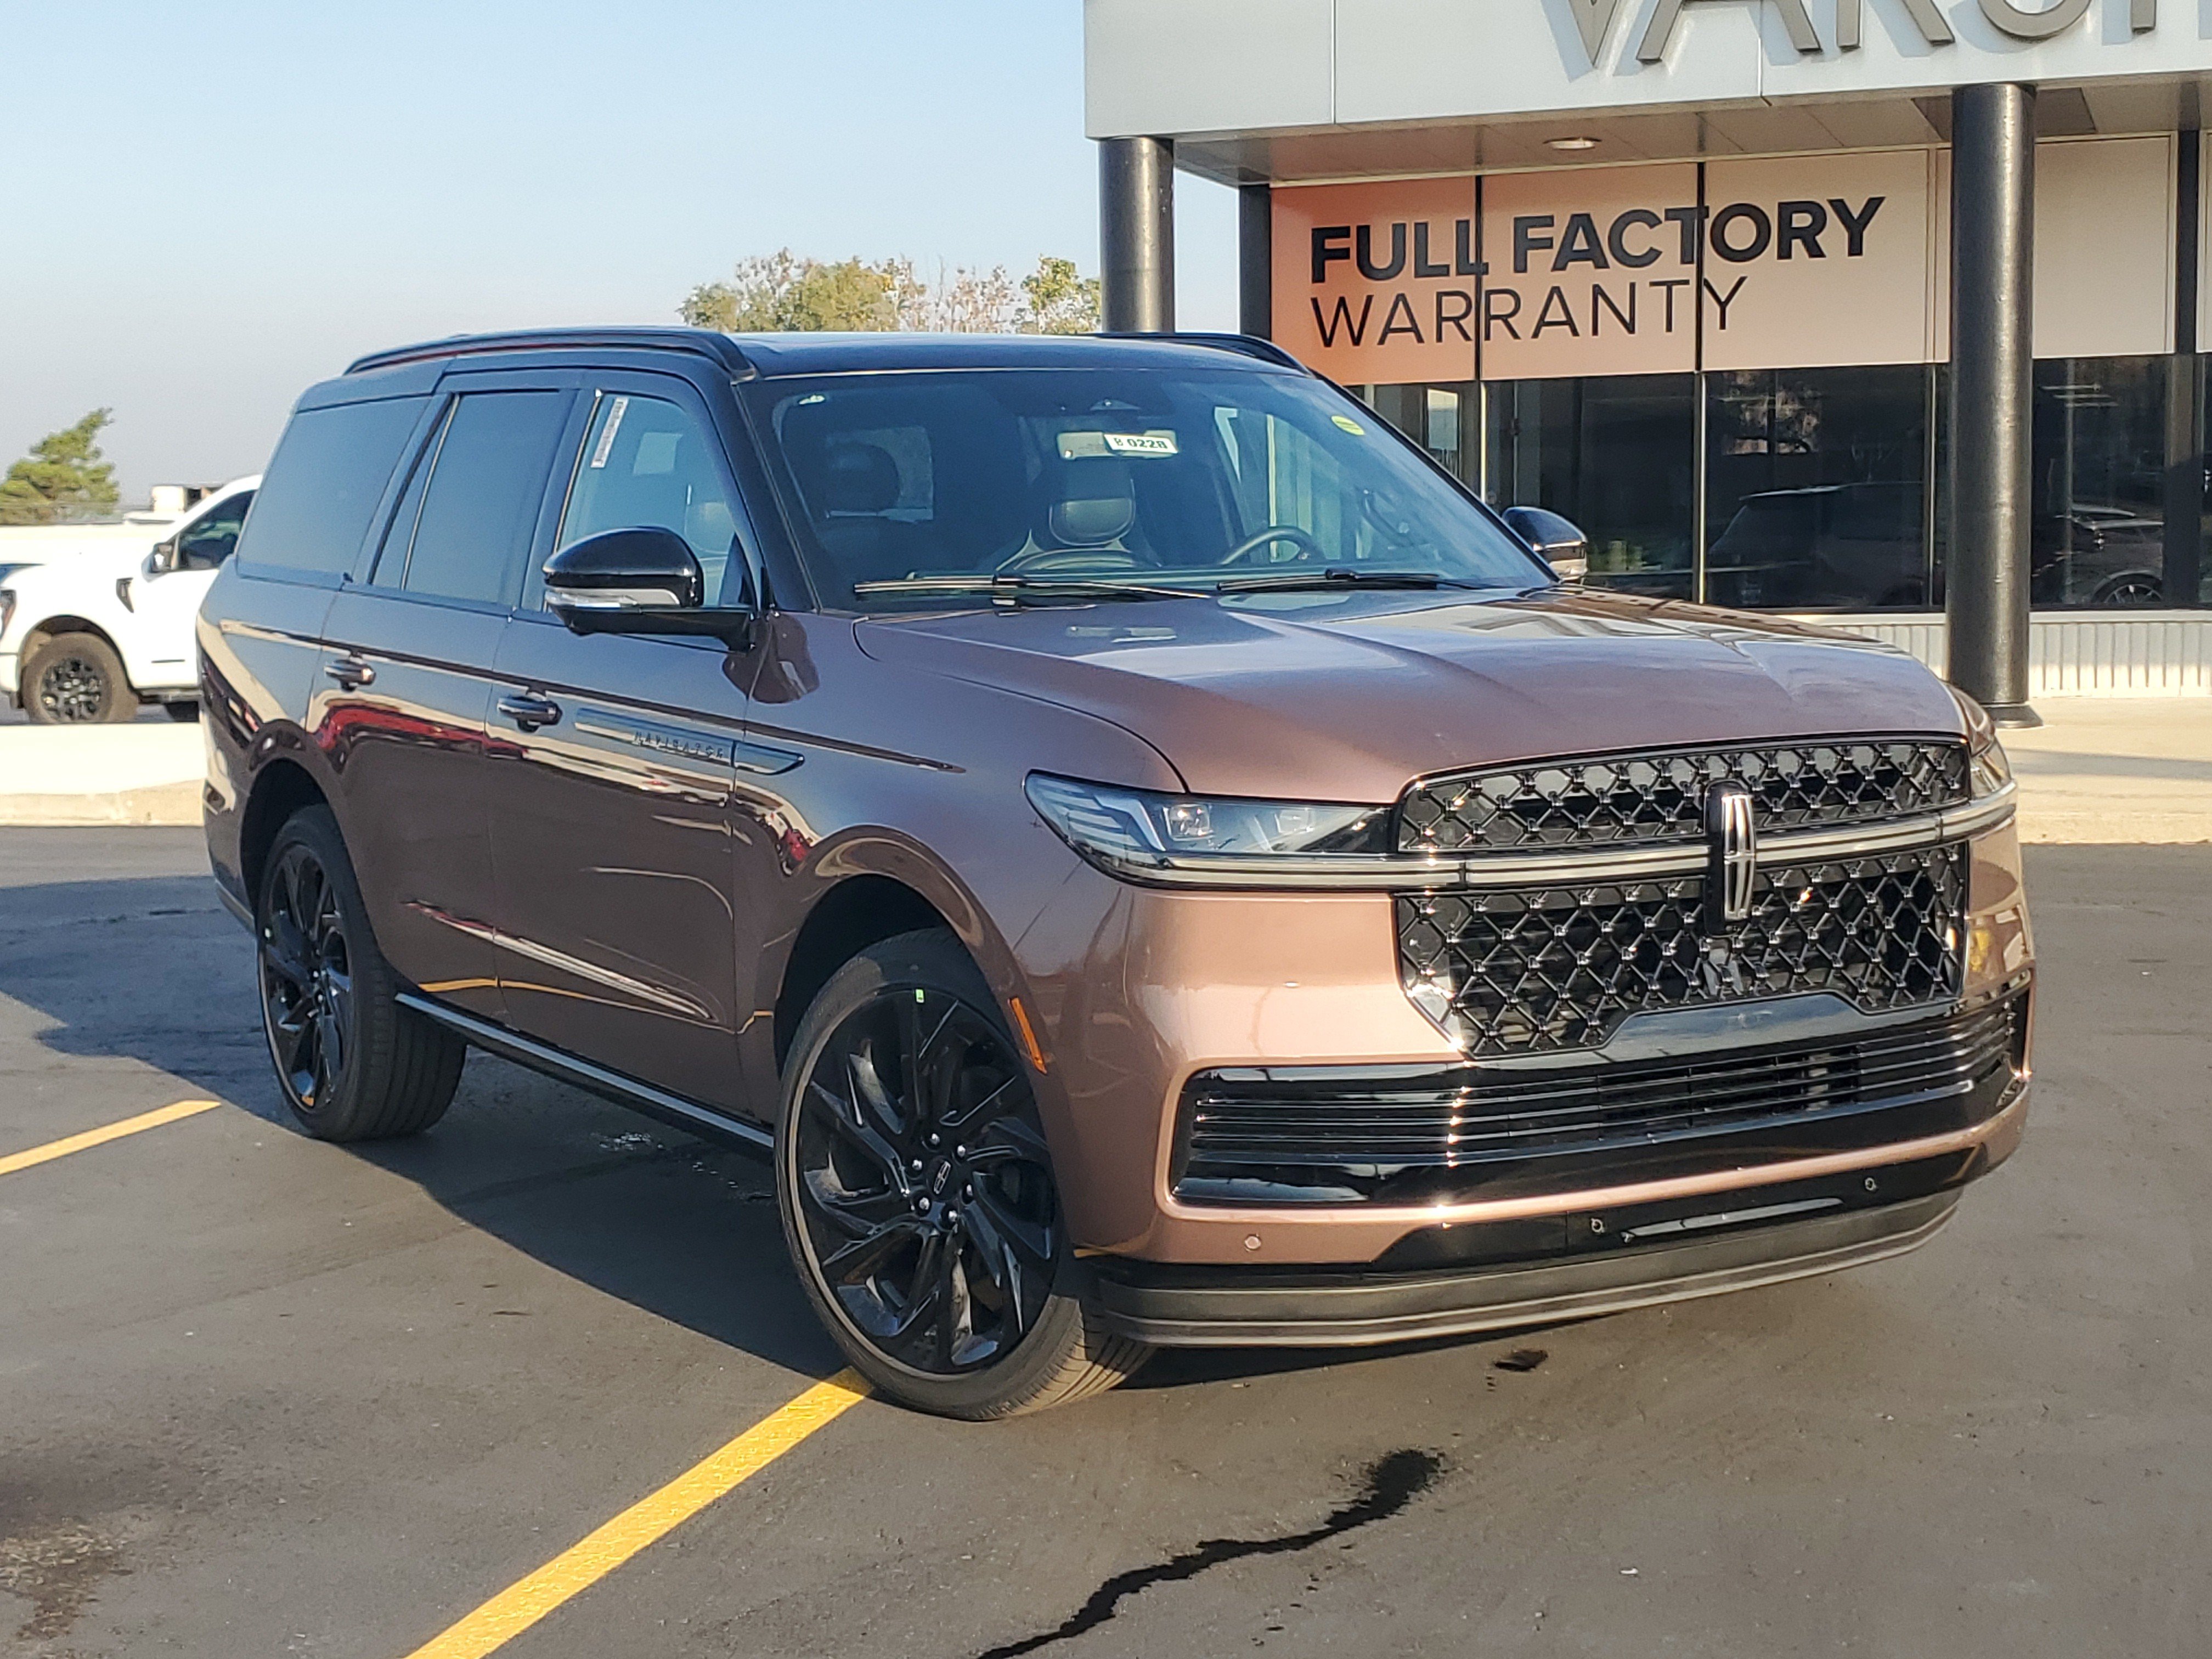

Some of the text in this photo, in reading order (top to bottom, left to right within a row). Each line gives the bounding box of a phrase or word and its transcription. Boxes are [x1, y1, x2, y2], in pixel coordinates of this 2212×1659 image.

[1311, 196, 1886, 284] FULL FACTORY
[1310, 275, 1748, 348] WARRANTY
